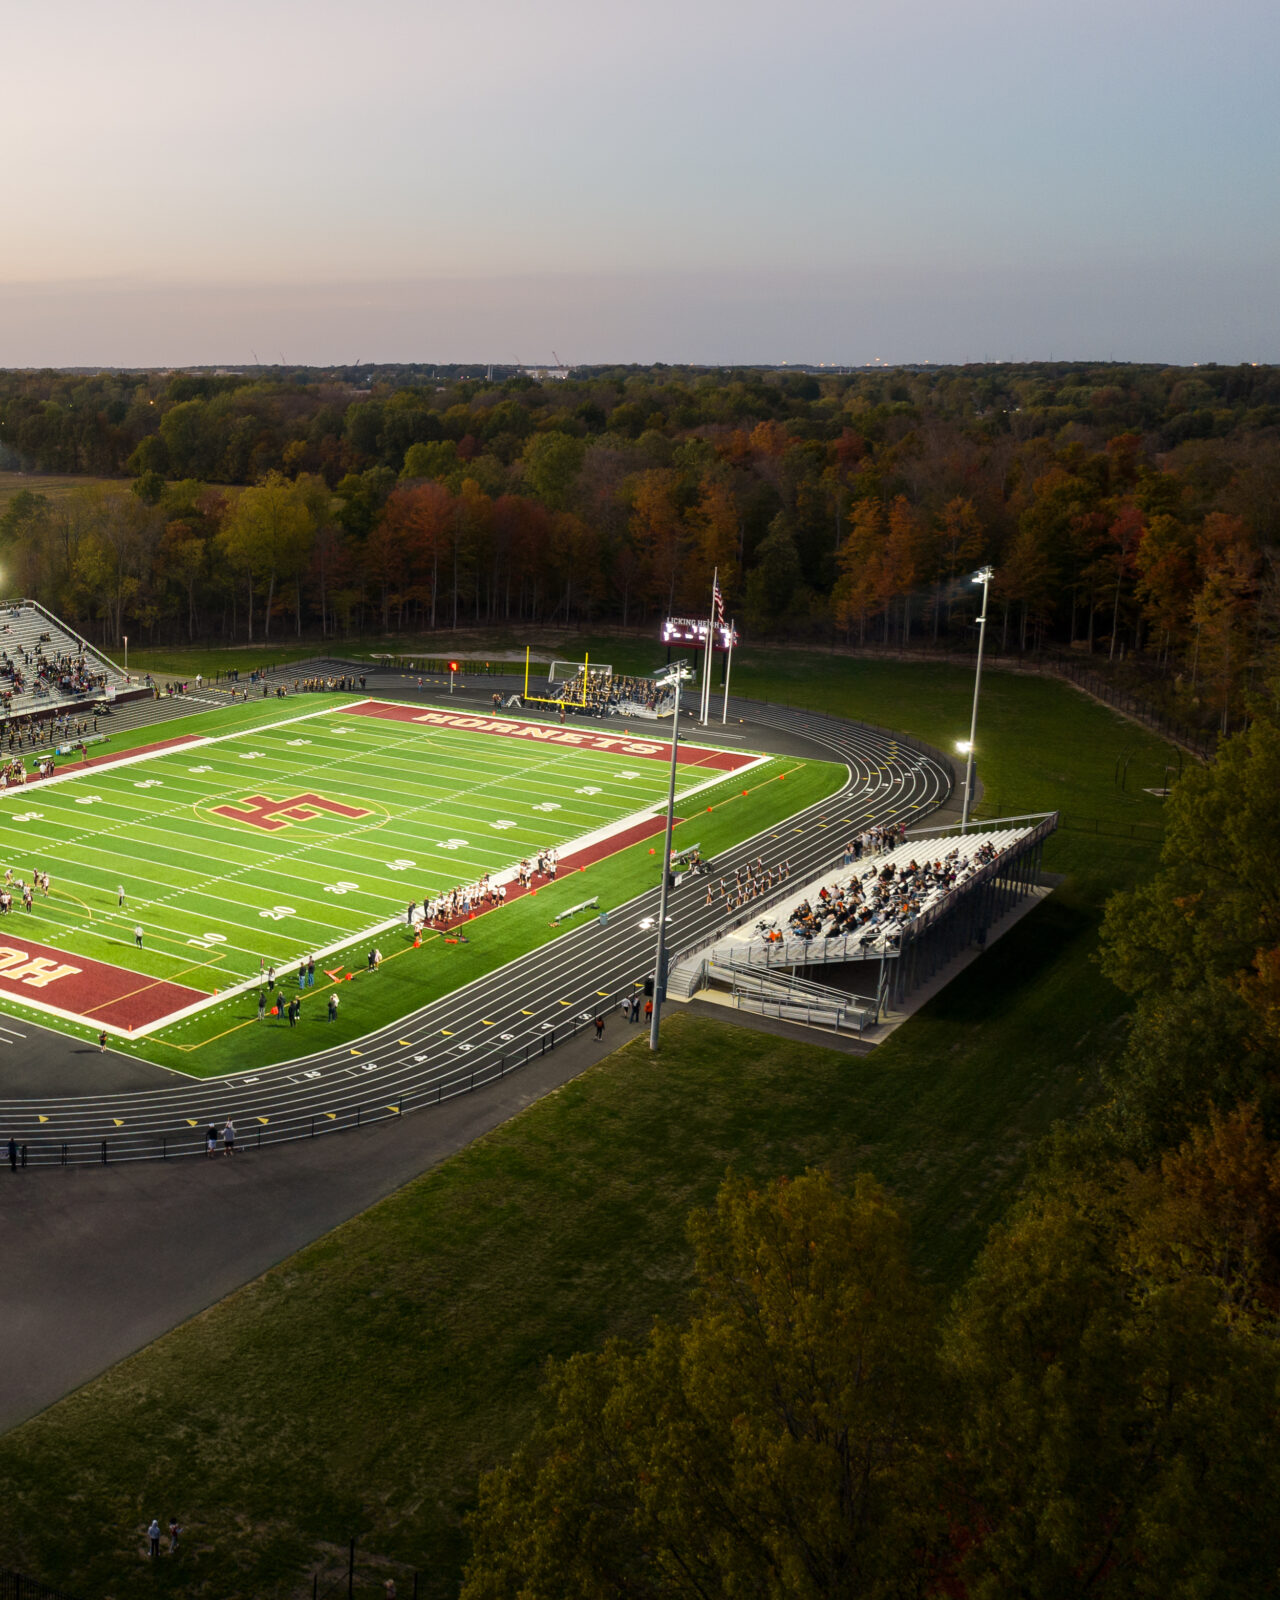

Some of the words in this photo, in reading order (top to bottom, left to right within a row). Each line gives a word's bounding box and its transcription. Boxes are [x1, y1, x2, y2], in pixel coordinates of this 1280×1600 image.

[667, 617, 696, 626] LICKING
[698, 620, 730, 630] HEGHTS
[411, 712, 664, 755] HORNETS
[134, 780, 164, 788] 50
[574, 786, 602, 796] 20
[532, 802, 562, 812] 30
[12, 812, 44, 822] 30
[488, 820, 518, 830] 40
[436, 839, 469, 850] 50
[385, 860, 416, 870] 40
[323, 882, 360, 894] 30
[258, 906, 296, 920] 20
[186, 933, 227, 948] 10
